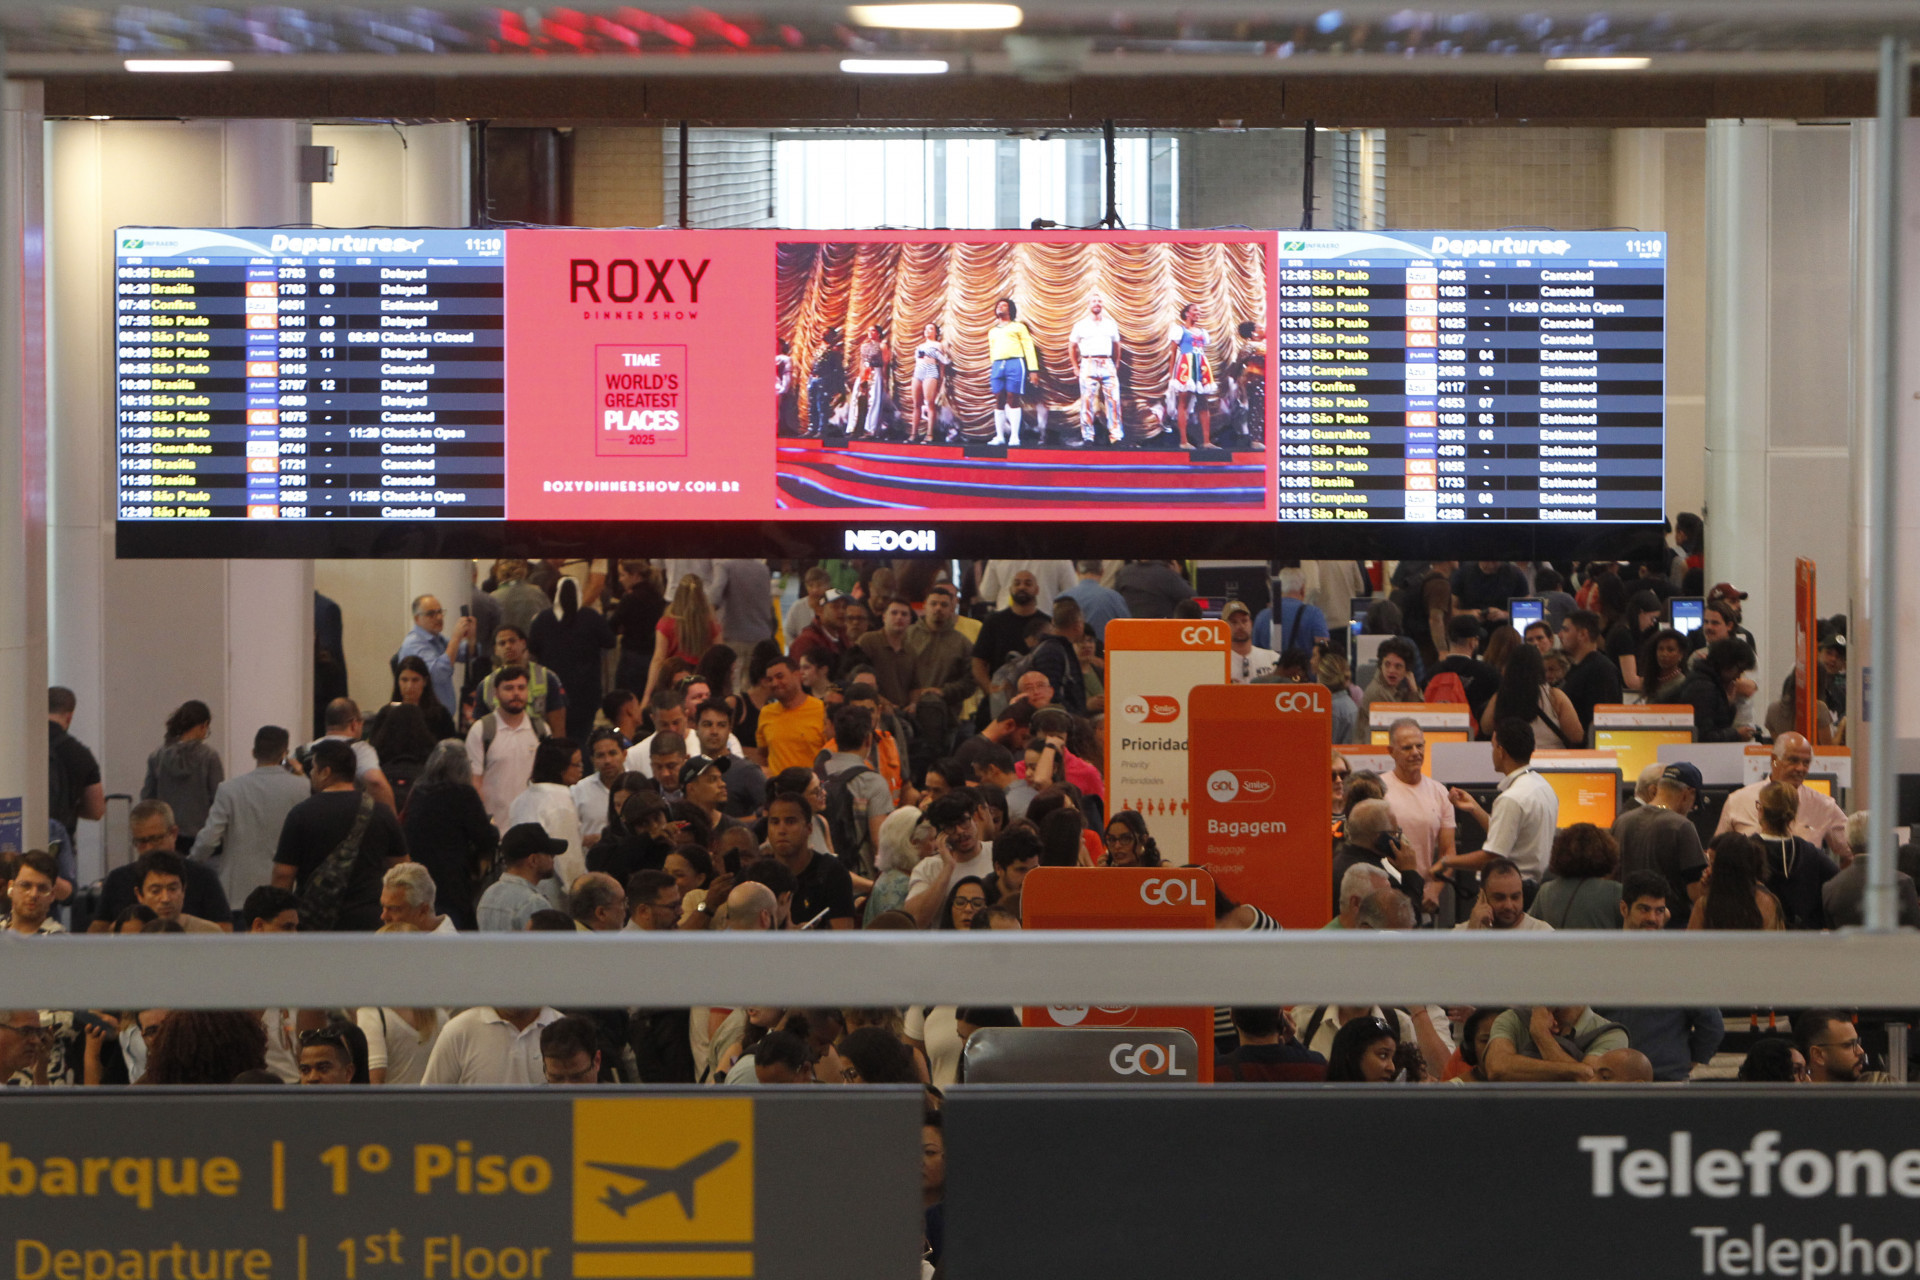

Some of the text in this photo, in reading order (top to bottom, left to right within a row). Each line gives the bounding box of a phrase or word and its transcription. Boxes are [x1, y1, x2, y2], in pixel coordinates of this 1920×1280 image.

[270, 234, 406, 255] Departures
[465, 239, 501, 251] 11:10
[1431, 236, 1564, 258] Departures
[1626, 240, 1661, 252] 11:10
[381, 268, 426, 281] Delayed
[1312, 270, 1334, 280] São
[1337, 270, 1369, 280] Paulo
[1541, 270, 1594, 281] Canceled
[570, 259, 711, 303] ROXY
[381, 284, 426, 296] Delayed
[1312, 286, 1334, 296] São
[1337, 286, 1369, 296] Paulo
[1541, 286, 1593, 296] Canceled
[152, 300, 438, 310] Confins Estimated
[1312, 302, 1334, 312] São
[1337, 302, 1369, 312] Paulo
[1541, 302, 1591, 313] Check-in
[1593, 302, 1624, 315] Open
[584, 311, 698, 320] DINNER SHOW
[152, 316, 427, 328] São Paulo Delayed
[1312, 318, 1334, 328] São
[1337, 318, 1369, 328] Paulo
[1541, 318, 1593, 328] Canceled
[152, 331, 473, 342] São Paulo Check-in Closed
[1312, 333, 1334, 344] São
[1336, 334, 1369, 344] Paulo
[1541, 334, 1593, 345] Canceled
[152, 347, 174, 357] São
[177, 348, 209, 357] Paulo
[381, 348, 427, 360] Delayed
[1312, 350, 1334, 359] São
[1337, 350, 1369, 360] Paulo
[1541, 350, 1597, 360] Estimated
[621, 353, 661, 367] TIME
[152, 363, 434, 374] São Paulo Canceled
[1312, 365, 1368, 378] Campinas
[1541, 366, 1597, 376] Estimated
[382, 380, 427, 392] Delayed
[605, 374, 679, 390] WORLD'S
[1312, 382, 1356, 391] Confins
[1541, 382, 1597, 392] Estimated
[152, 395, 427, 408] São Paulo Delayed
[605, 393, 679, 408] GREATEST
[1312, 397, 1334, 407] São
[1336, 397, 1368, 407] Paulo
[1541, 398, 1597, 408] Estimated
[152, 411, 434, 422] São Paulo Canceled
[604, 410, 680, 431] PLACES
[1312, 413, 1333, 423] São
[1336, 413, 1368, 423] Paulo
[1541, 414, 1597, 424] Estimated
[152, 427, 175, 437] São
[177, 427, 210, 437] Paulo
[382, 427, 432, 438] Check-in
[434, 428, 465, 440] Open
[628, 434, 655, 445] 2025
[1312, 429, 1370, 439] Guarulhos
[1541, 430, 1597, 440] Estimated
[152, 443, 212, 453] Guarulhos
[382, 443, 434, 454] Canceled
[1312, 445, 1333, 455] São
[1336, 445, 1368, 455] Paulo
[1541, 446, 1596, 456] Estimated
[382, 459, 435, 470] Canceled
[1311, 461, 1333, 471] São
[1336, 461, 1368, 471] Paulo
[1541, 462, 1596, 472] Estimated
[382, 475, 435, 485] Canceled
[543, 480, 740, 492] ROXYDINNERSHOW.COM.BR
[1541, 477, 1596, 488] Estimated
[152, 491, 465, 503] São Paulo Check-in Open
[1311, 493, 1367, 505] Campinas
[1541, 493, 1596, 504] Estimated
[152, 507, 435, 517] São Paulo Canceled
[1311, 508, 1333, 519] São
[1336, 508, 1368, 519] Paulo
[1541, 509, 1596, 519] Estimated
[844, 530, 936, 551] NEOOH
[1180, 626, 1225, 645] GOL
[1275, 691, 1325, 713] GOL
[1125, 704, 1177, 715] GOL Smiles
[1121, 761, 1150, 770] Priority
[1121, 776, 1164, 785] Prioridades
[1211, 780, 1270, 792] GOL Smiles
[1208, 819, 1287, 837] Bagagem
[1207, 845, 1246, 856] Baggage
[1207, 863, 1244, 873] Equipaje
[1140, 878, 1206, 906] GOL
[1109, 1043, 1187, 1076] GOL
[414, 1140, 553, 1195] Piso
[15, 1239, 272, 1280] Departure
[424, 1234, 551, 1280] Floor
[1691, 1223, 1920, 1280] Telepho
